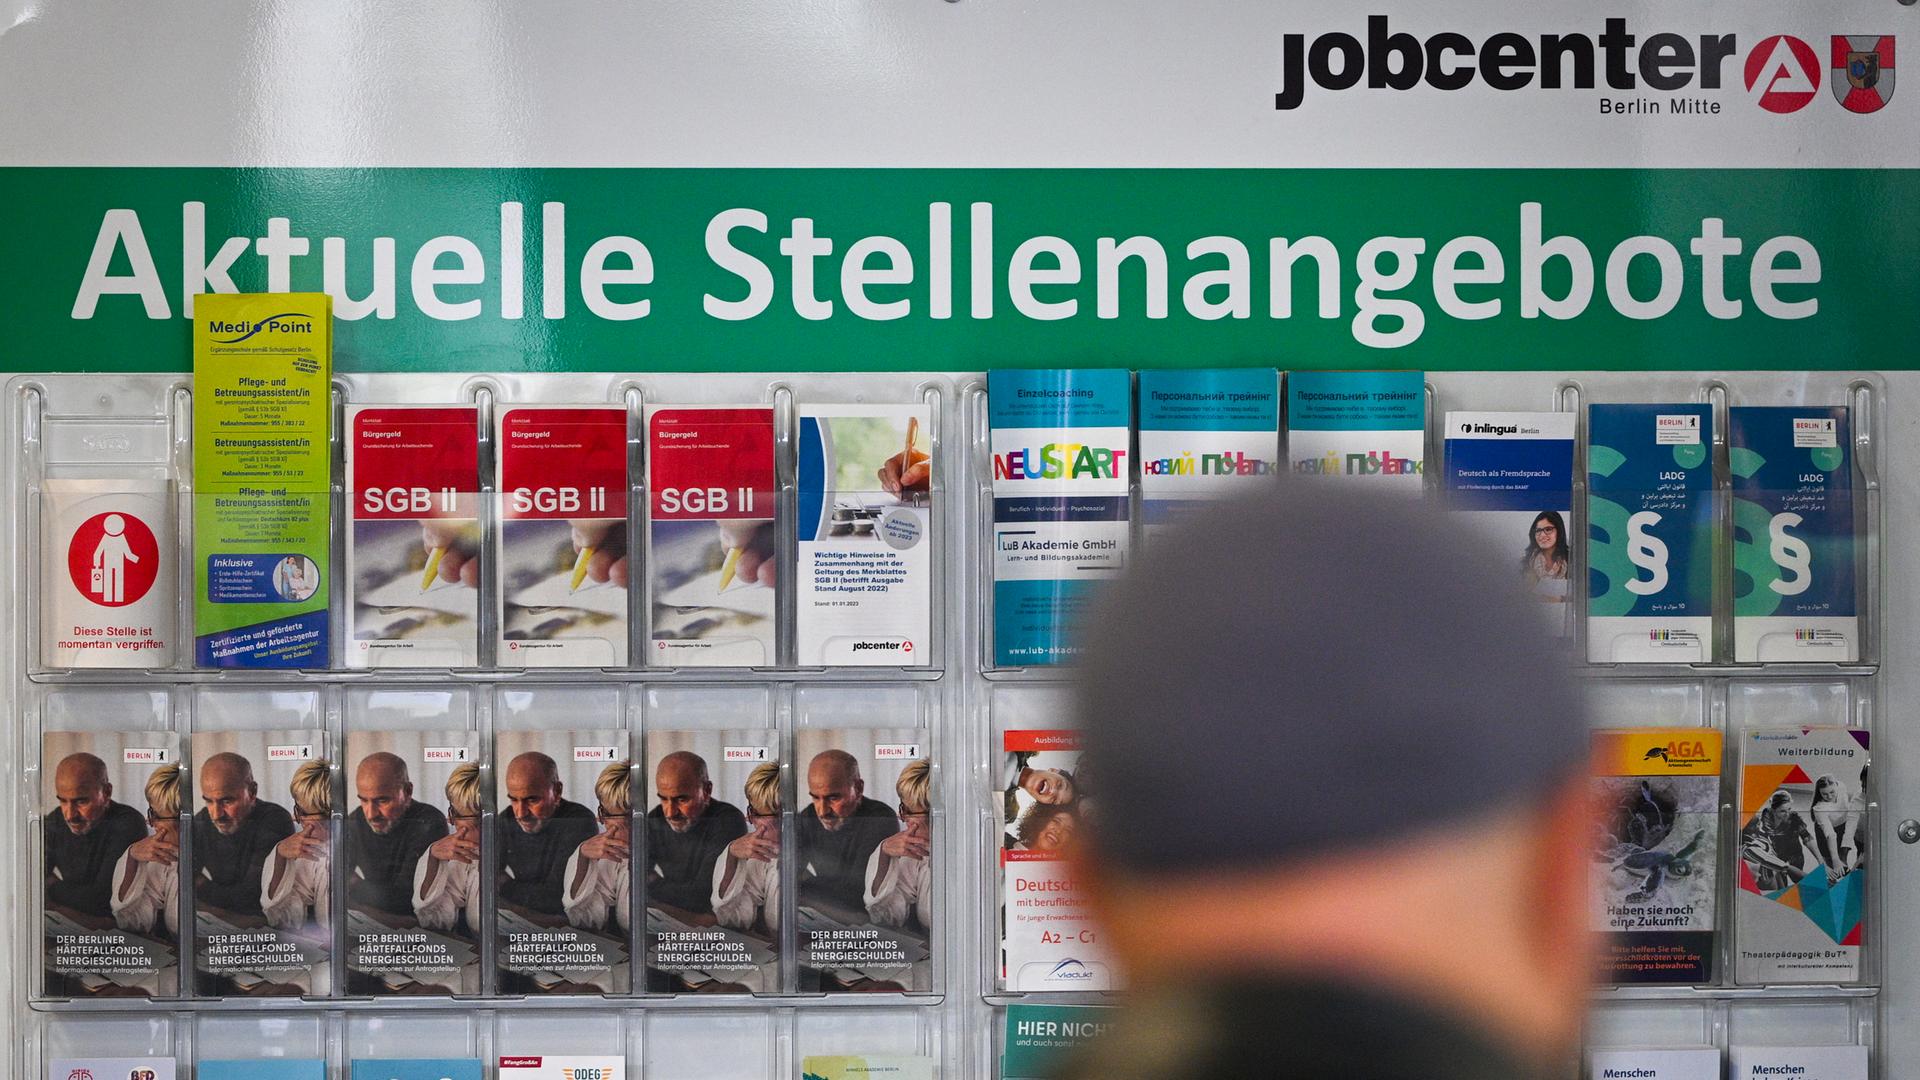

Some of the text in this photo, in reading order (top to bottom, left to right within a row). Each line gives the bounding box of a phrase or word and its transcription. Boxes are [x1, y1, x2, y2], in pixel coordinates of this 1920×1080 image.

[1275, 15, 1736, 110] jobcenter
[1600, 98, 1721, 114] Berlin Mitte
[71, 202, 1822, 348] Aktuelle Stellenangebote
[269, 321, 312, 333] Point
[239, 378, 286, 388] Pflege- und
[215, 388, 310, 398] Betreuungsassistent/in
[1017, 389, 1094, 398] Einzelcoaching
[1151, 391, 1271, 402] Персональний трейнінг
[1297, 391, 1417, 402] Персональний трейнінг
[1474, 423, 1517, 436] inlingua
[363, 431, 401, 439] Bürgergeld
[511, 431, 550, 439] Bürgergeld
[659, 431, 698, 439] Bürgergeld
[215, 438, 310, 448] Betreuungsassistent/in
[994, 443, 1126, 480] NEUSTART
[1500, 469, 1551, 478] Fremdsprache
[1659, 471, 1685, 480] LADG
[1798, 474, 1824, 482] LADG
[239, 488, 286, 498] Pflege- und
[215, 498, 310, 508] Betreuungsassistent/in
[364, 487, 456, 512] SGB II
[512, 487, 605, 512] SGB II
[660, 487, 753, 513] SGB II
[1070, 505, 1105, 513] Psychosozial
[891, 519, 915, 529] Aktuelle
[1002, 540, 1116, 550] LuB Akademie GmbH
[814, 552, 847, 560] Wichtige
[1041, 554, 1110, 562] Bildungsakademie
[214, 559, 254, 568] Inklusive
[814, 560, 874, 568] Zusammenhang
[840, 577, 869, 585] (betrifft
[871, 577, 904, 585] Ausgabe
[838, 585, 865, 593] August
[867, 585, 888, 593] 2022)
[74, 626, 152, 636] Diese Stelle ist
[210, 623, 303, 648] Zertifizierte und geförderte
[58, 640, 166, 651] momentan vergriffen.
[212, 630, 320, 658] Maßnahmen der Arbeitsagentur
[853, 641, 900, 652] jobcenter
[1034, 736, 1073, 745] Ausbildung
[1667, 741, 1705, 757] AGA
[1778, 748, 1854, 757] Weiterbildung
[1016, 898, 1032, 907] mit
[1607, 905, 1694, 915] Haben sie noch
[1610, 916, 1689, 927] eine Zukunft?
[56, 935, 125, 944] DER BERLINER
[208, 933, 276, 944] DER BERLINER
[359, 934, 427, 943] DER BERLINER
[509, 933, 577, 942] DER BERLINER
[658, 932, 726, 941] DER BERLINER
[811, 930, 878, 939] DER BERLINER
[1041, 930, 1061, 944] A2
[1079, 930, 1096, 944] C1
[208, 943, 296, 954] HÄRTEFALLFONDS
[359, 943, 446, 953] HÄRTEFALLFONDS
[509, 942, 597, 952] HÄRTEFALLFONDS
[658, 940, 745, 951] HÄRTEFALLFONDS
[811, 938, 898, 950] HÄRTEFALLFONDS
[56, 944, 144, 955] HÄRTEFALLFONDS
[209, 954, 304, 965] ENERGIESCHULDEN
[359, 955, 454, 964] ENERGIESCHULDEN
[509, 954, 604, 963] ENERGIESCHULDEN
[658, 953, 752, 962] ENERGIESCHULDEN
[811, 951, 905, 960] ENERGIESCHULDEN
[1742, 951, 1821, 959] Theaterpädagogik
[56, 957, 152, 966] ENERGIESCHULDEN
[1018, 1021, 1114, 1037] HIER NICH
[1016, 1038, 1031, 1046] und
[574, 1068, 601, 1080] ODEG
[1603, 1068, 1656, 1078] Menschen
[1752, 1065, 1805, 1075] Menschen
